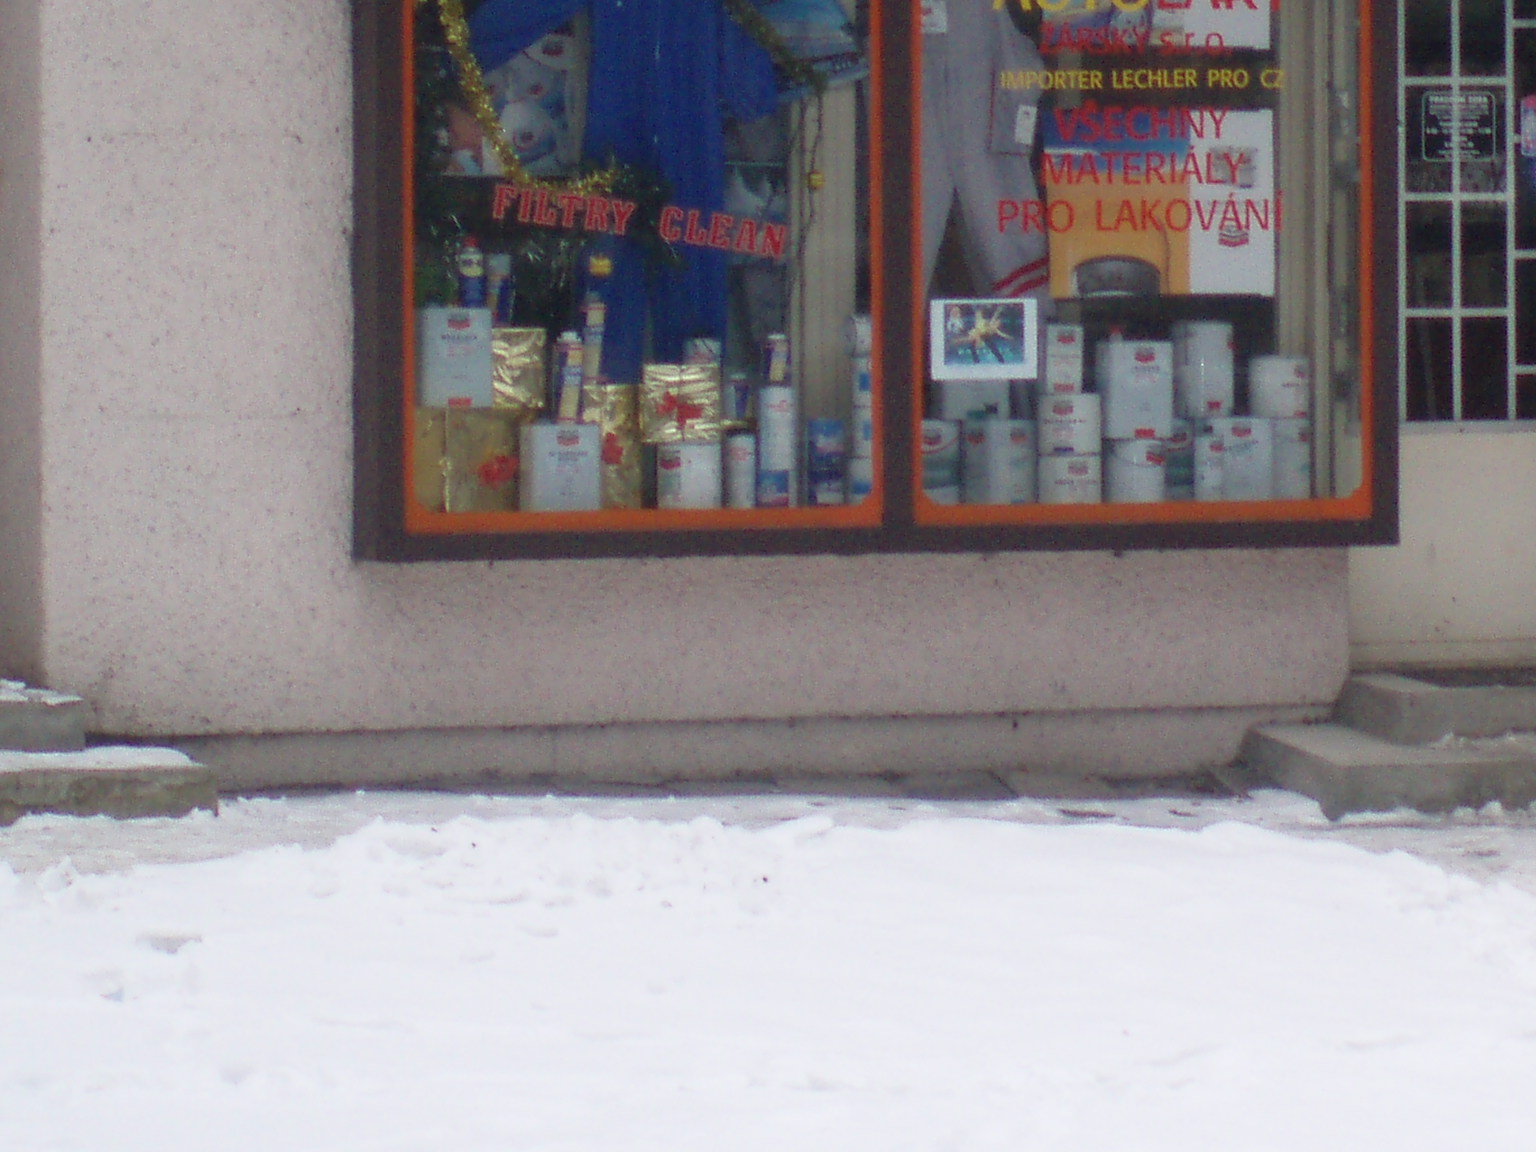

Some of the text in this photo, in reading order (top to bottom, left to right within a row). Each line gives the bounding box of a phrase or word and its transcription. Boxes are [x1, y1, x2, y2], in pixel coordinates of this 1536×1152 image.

[1001, 68, 1286, 90] IMPORTER LECHLER PRO CZ
[1054, 100, 1229, 141] VŠECHNY
[1041, 145, 1247, 184] MATERIÁLY
[492, 183, 789, 259] FILTRY CLEAN
[996, 191, 1285, 234] PRO LAKOVÁNÍ
